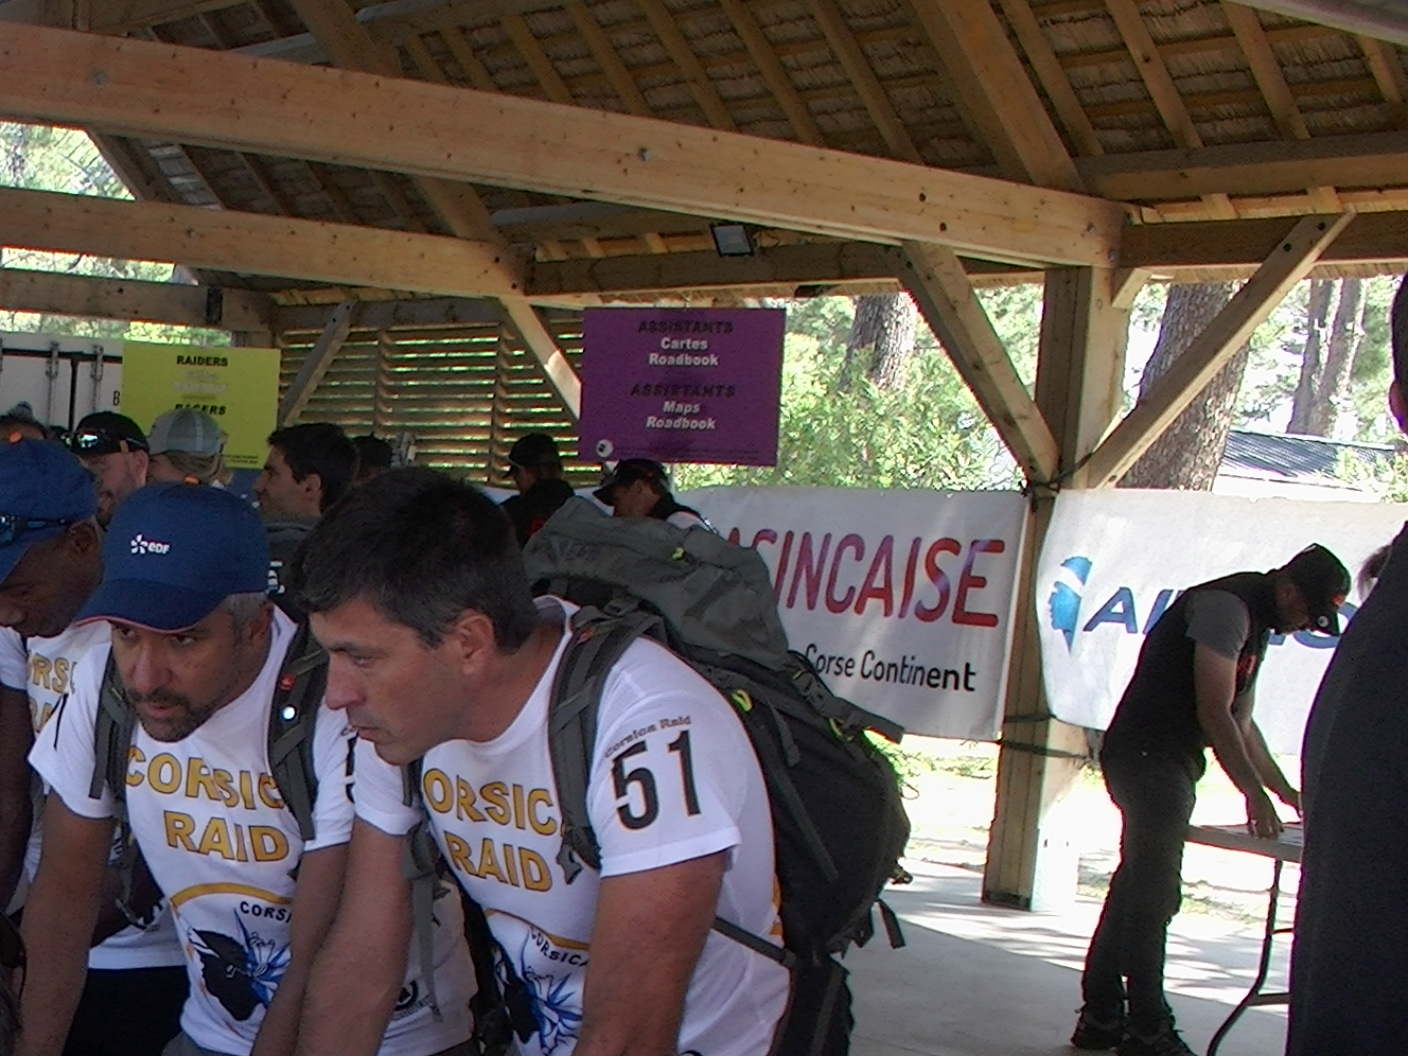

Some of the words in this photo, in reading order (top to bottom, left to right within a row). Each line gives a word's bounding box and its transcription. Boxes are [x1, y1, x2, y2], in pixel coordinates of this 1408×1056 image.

[176, 355, 228, 367] RAIDERS
[649, 353, 718, 366] Roadbook
[661, 337, 708, 350] Cartes
[646, 416, 716, 430] Roadbook
[663, 401, 700, 415] Maps
[727, 526, 1005, 628] INCAISE
[805, 643, 855, 677] Corse
[860, 650, 977, 691] Continent
[611, 729, 702, 831] 51
[163, 811, 290, 863] RAID
[443, 829, 553, 893] RAID
[530, 926, 589, 967] ORSIC
